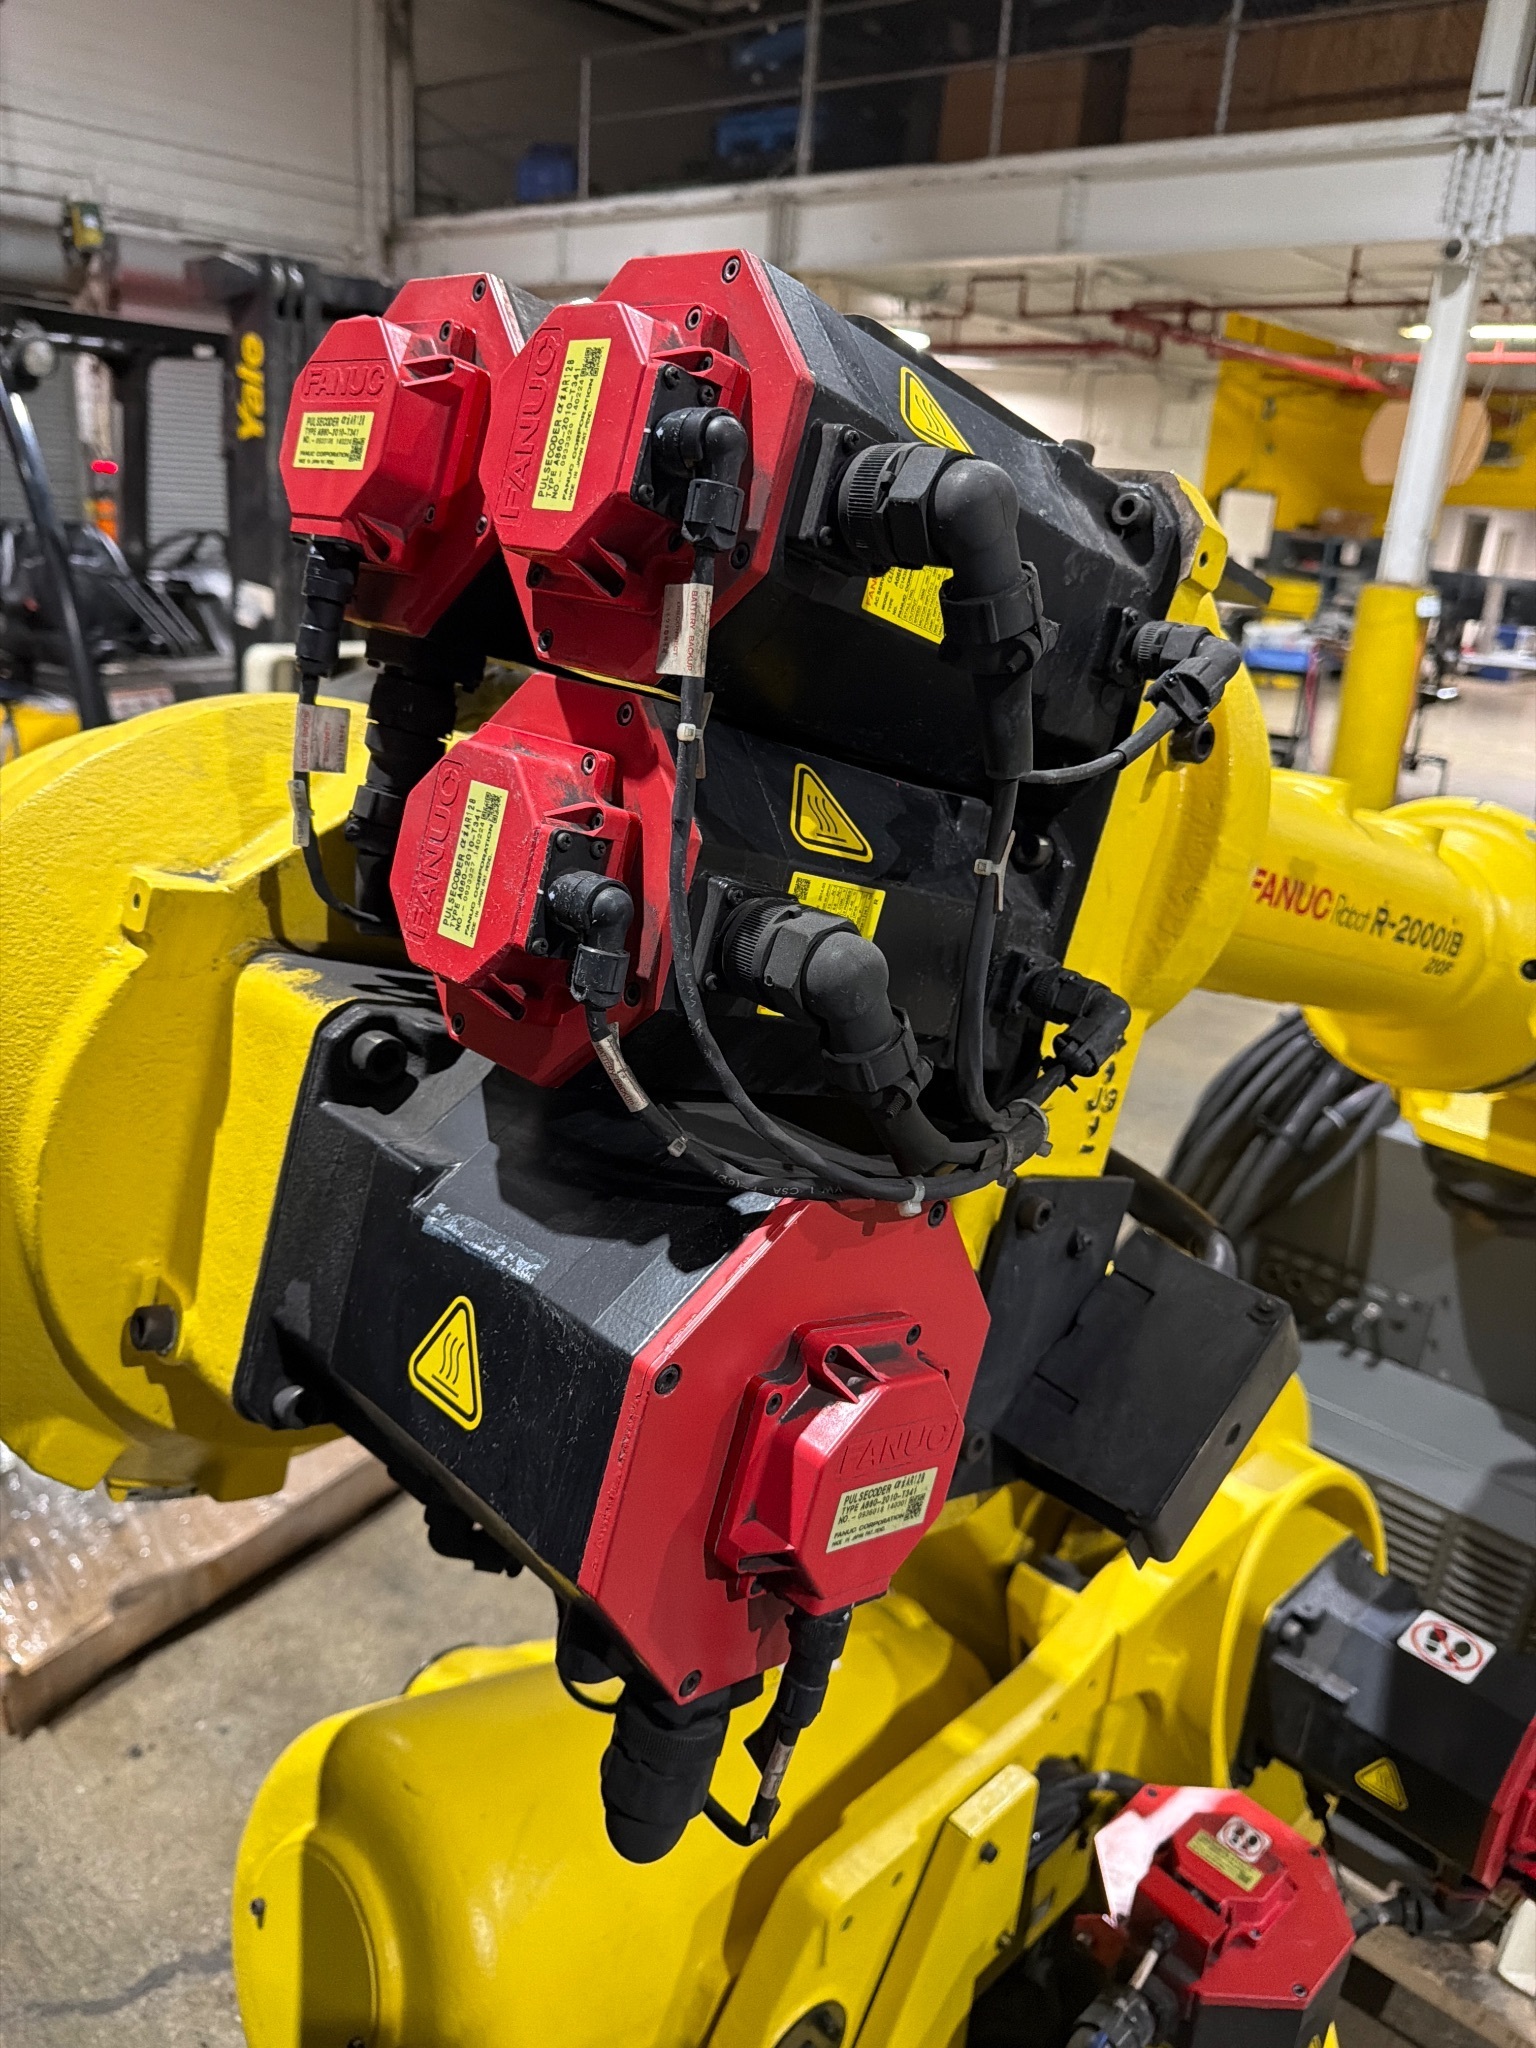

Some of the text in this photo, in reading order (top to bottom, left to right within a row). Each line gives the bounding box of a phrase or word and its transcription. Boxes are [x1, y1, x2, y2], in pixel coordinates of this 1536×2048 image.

[236, 331, 265, 441] Yale
[304, 366, 385, 396] FANUC
[571, 379, 584, 416] 140224
[500, 337, 557, 519] FANUC
[545, 368, 581, 497] TYPE A860-2010-T341
[561, 378, 594, 500] FANUC CORPORATION
[538, 420, 561, 497] PULSECODER
[567, 484, 575, 501] MADE
[575, 447, 584, 468] JAPAN
[686, 590, 699, 671] BATTERY BACKUP
[405, 768, 460, 940] FANUC
[473, 822, 485, 855] 140224
[443, 854, 465, 925] PULSECODER
[450, 809, 483, 927] TYPE A860-2010-T341
[464, 824, 494, 935] FANUC CORPORATION
[469, 922, 477, 938] MADE
[1331, 894, 1371, 933] Robot
[596, 1045, 634, 1105] BATTERY BACKUP
[1086, 1088, 1118, 1113] J3
[773, 1187, 799, 1195] CSA
[839, 1425, 946, 1475] FANUC
[842, 1503, 859, 1514] TYPE
[844, 1484, 892, 1506] PULSECODER
[834, 1514, 904, 1538] FANUC CORPORATION
